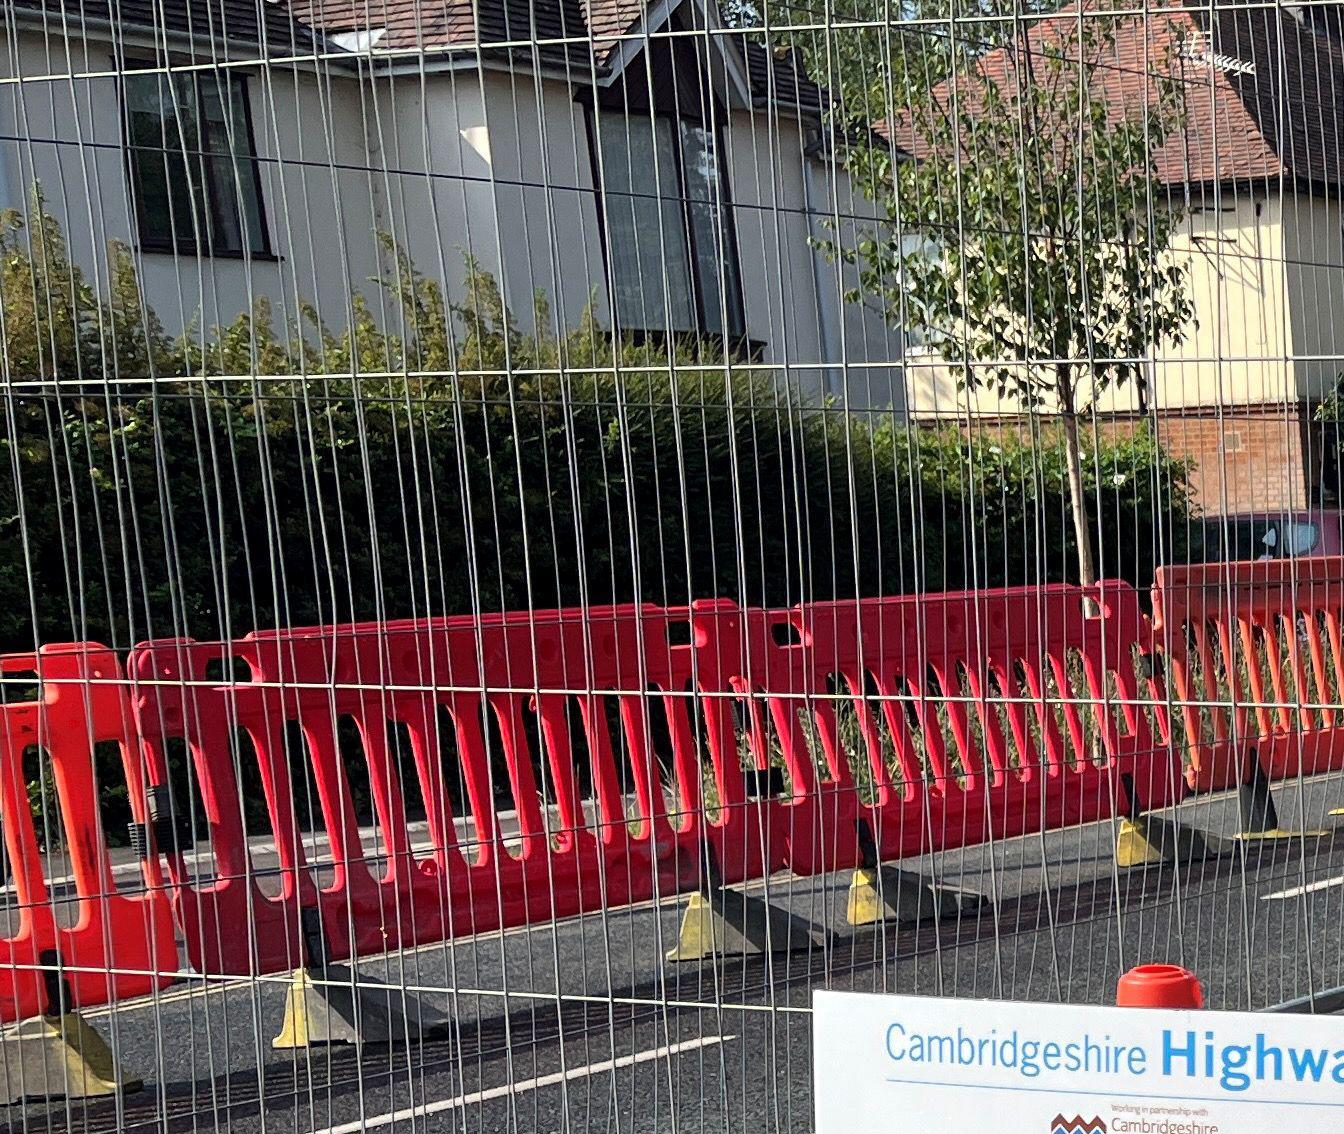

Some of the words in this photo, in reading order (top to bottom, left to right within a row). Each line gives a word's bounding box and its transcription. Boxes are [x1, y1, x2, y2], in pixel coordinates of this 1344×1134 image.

[886, 1023, 1146, 1077] Cambridgeshire
[1111, 1104, 1141, 1115] Working
[1149, 1107, 1191, 1116] partnership
[1193, 1108, 1209, 1116] with
